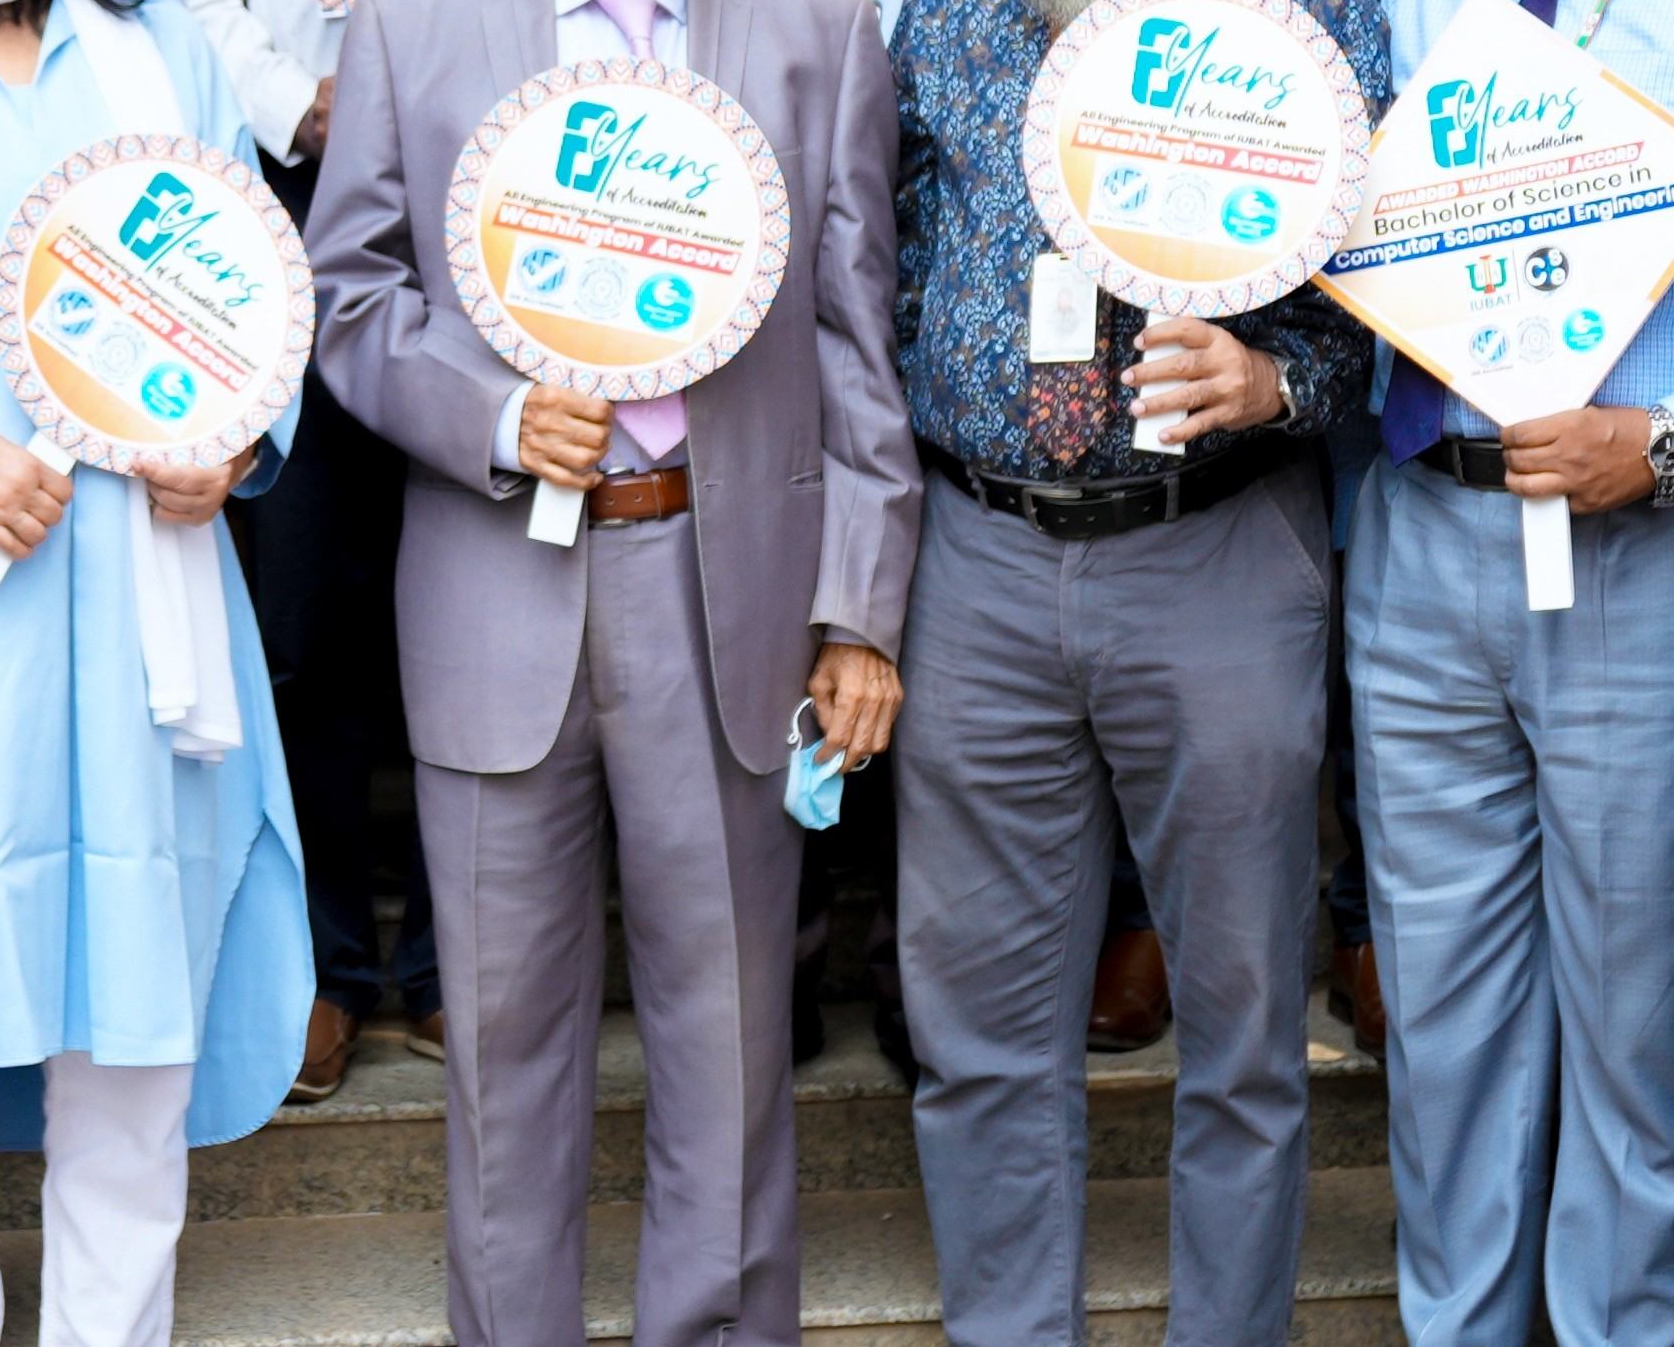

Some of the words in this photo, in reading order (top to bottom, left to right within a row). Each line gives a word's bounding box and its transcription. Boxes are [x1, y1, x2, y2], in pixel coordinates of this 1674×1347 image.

[1165, 26, 1299, 118] Years
[1081, 110, 1096, 119] All
[1098, 112, 1167, 132] Engineering
[1170, 124, 1221, 141] Program
[1237, 133, 1270, 147] IUBAT
[1273, 140, 1326, 156] Awarded
[1184, 101, 1195, 117] of
[1199, 99, 1287, 128] Accreditation
[1457, 71, 1583, 170] Years
[591, 113, 722, 202] Years
[1078, 124, 1225, 162] Washington
[1230, 150, 1322, 179] Accord
[1376, 181, 1460, 212] AWARDED
[1463, 159, 1569, 195] WASHINGTON
[1571, 144, 1641, 172] ACCORD
[1486, 149, 1497, 162] of
[1501, 133, 1584, 159] Accreditation
[520, 194, 588, 216] Engineering
[591, 209, 641, 227] Program
[692, 231, 745, 248] Awarded
[607, 187, 618, 203] of
[621, 188, 707, 218] Accreditation
[1374, 197, 1486, 236] Bachelor
[1493, 192, 1516, 212] of
[1522, 172, 1622, 206] Science
[1629, 164, 1652, 184] in
[146, 200, 265, 307] Years
[498, 204, 643, 249] Washington
[648, 239, 739, 272] Accord
[1335, 233, 1444, 269] Computer
[1443, 218, 1525, 250] Science
[1529, 207, 1571, 231] and
[53, 234, 175, 336] Washington
[171, 330, 249, 390] Accord
[1470, 294, 1511, 312] IUBAT
